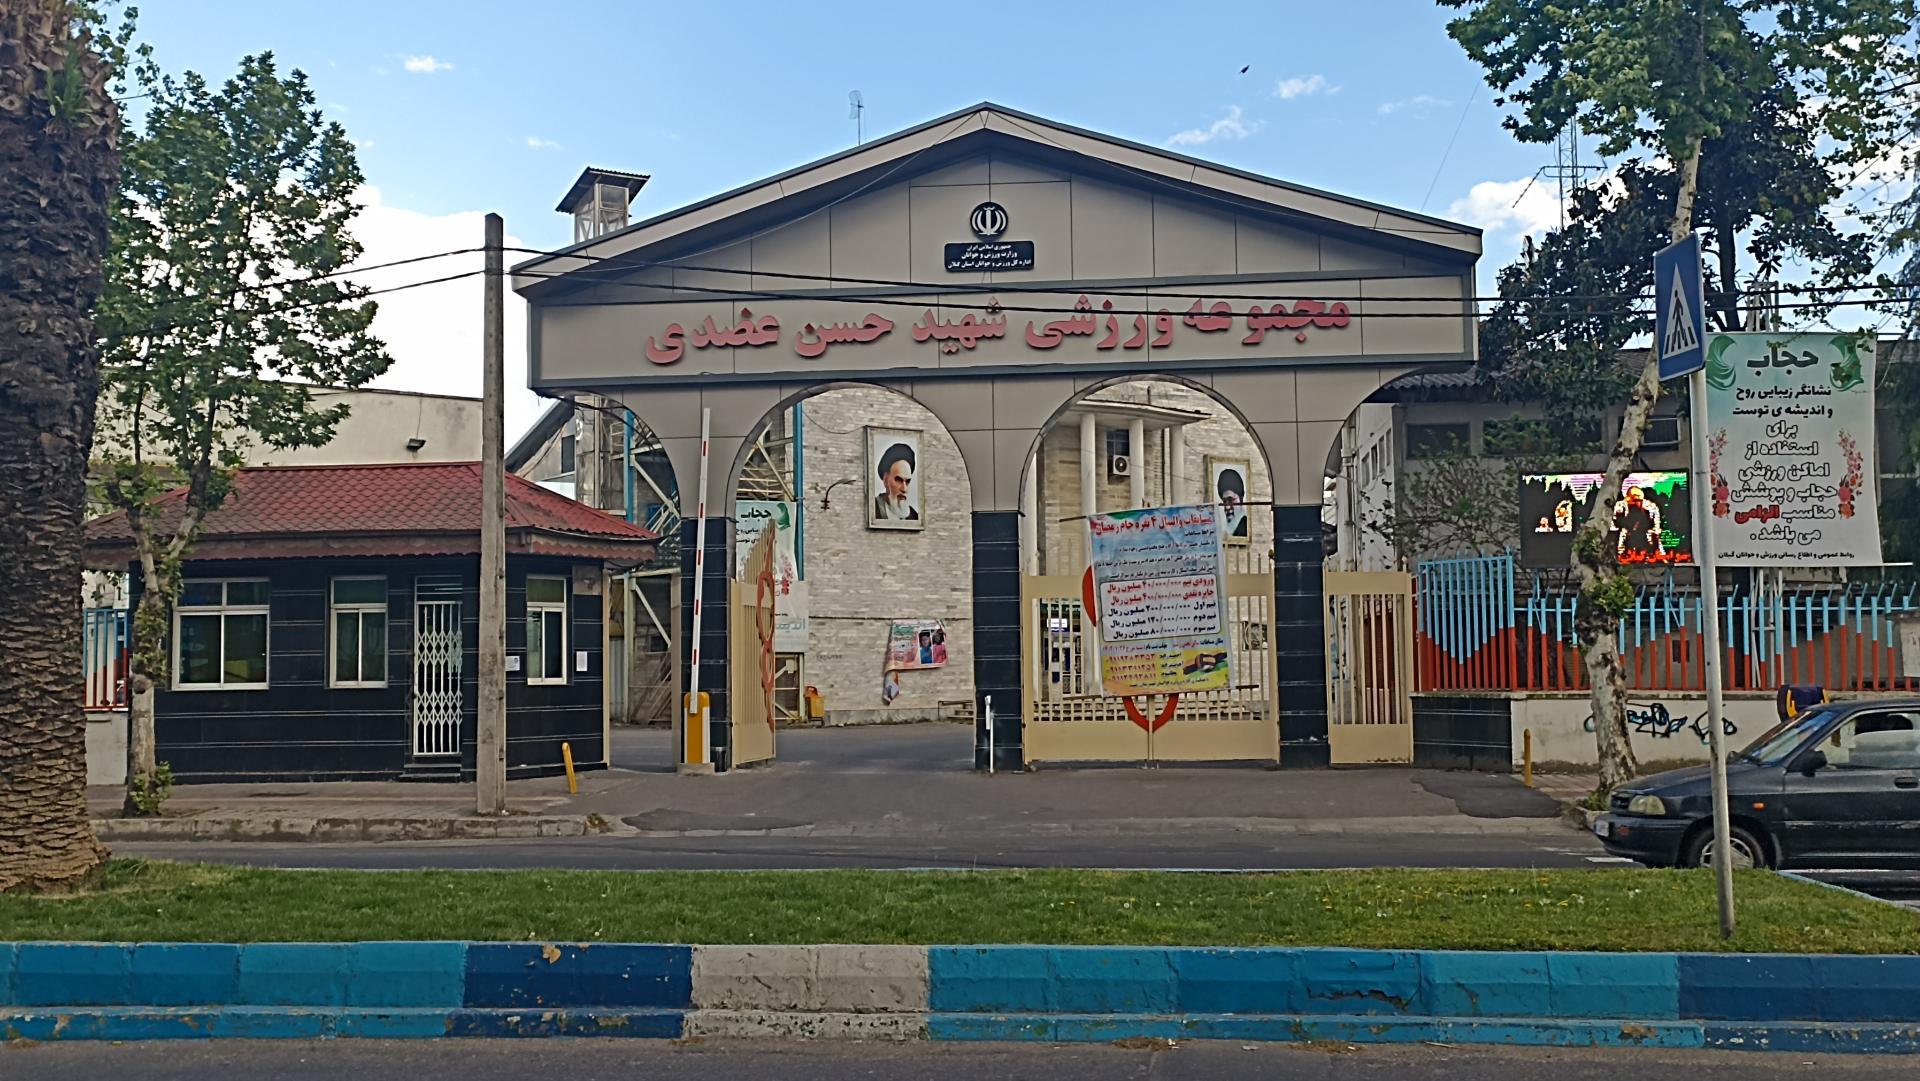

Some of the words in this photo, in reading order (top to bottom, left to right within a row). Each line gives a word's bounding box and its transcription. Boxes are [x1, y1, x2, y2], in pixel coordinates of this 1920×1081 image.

[961, 251, 979, 259] جوانان
[1001, 250, 1018, 258] وزارت
[911, 296, 1007, 354] شهید
[1024, 294, 1175, 349] ورزشی
[1182, 298, 1350, 343] مجموعه
[645, 307, 781, 364] عضدی
[795, 313, 894, 357] حسن
[1747, 347, 1819, 376] حجاب
[1736, 386, 1756, 400] روح
[1758, 385, 1793, 399] زیبایی
[1795, 384, 1831, 400] نشانگر
[1732, 405, 1769, 418] توست
[1772, 408, 1782, 418] ی
[1785, 404, 1825, 419] اندیشه
[1828, 409, 1833, 419] و
[1766, 420, 1799, 439] برای
[1745, 441, 1759, 460] از
[1760, 440, 1819, 456] استفاده
[1738, 461, 1786, 482] ورزشی
[1787, 462, 1831, 481] اماکن
[1731, 482, 1785, 504] پوشش
[1786, 488, 1796, 502] و
[1797, 483, 1838, 502] حجاب
[741, 507, 772, 523] حجاب
[1734, 504, 1780, 524] الزامی
[1781, 504, 1836, 523] مناسب
[1797, 529, 1821, 545] می
[1760, 550, 1778, 559] ورزش
[1818, 552, 1838, 560] عمومی
[1108, 607, 1124, 617] ریال
[1124, 606, 1145, 616] میلیون
[1193, 601, 1206, 610] اول
[1110, 619, 1126, 628] ریال
[1126, 617, 1146, 627] میلیون
[1193, 613, 1206, 622] دوم
[1113, 630, 1128, 639] ریال
[1128, 628, 1149, 638] میلیون
